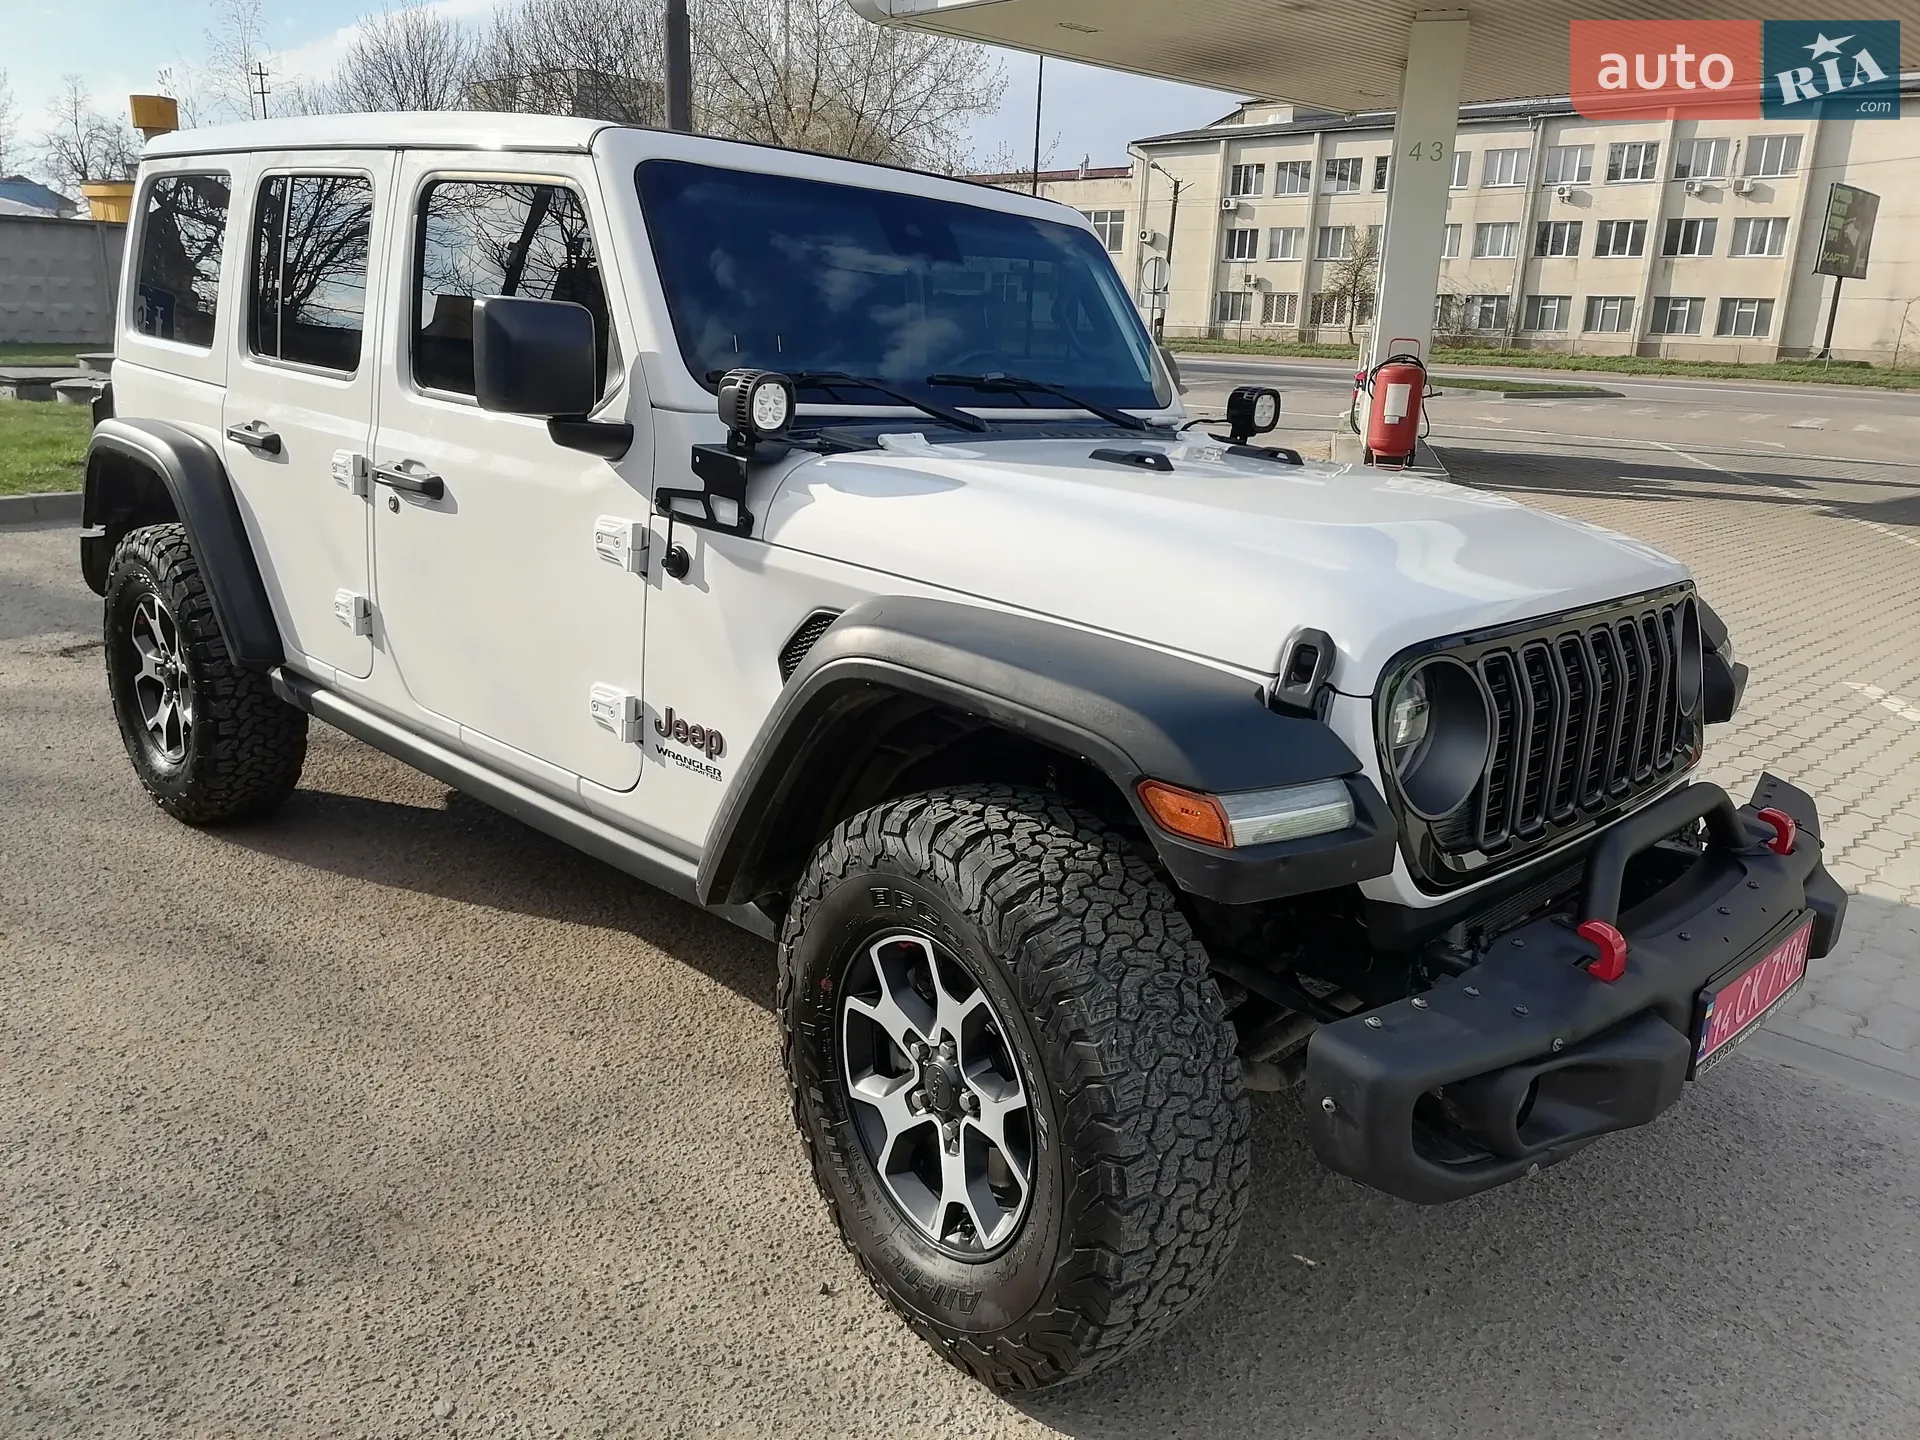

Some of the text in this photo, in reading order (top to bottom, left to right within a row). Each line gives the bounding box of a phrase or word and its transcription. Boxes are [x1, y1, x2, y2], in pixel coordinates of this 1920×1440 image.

[1408, 141, 1443, 162] 43
[653, 706, 724, 761] Jeep
[655, 744, 722, 778] WRANGLER
[675, 760, 723, 783] UNLIMITED
[1713, 1001, 1733, 1046] 14
[1766, 928, 1808, 1001] 7104
